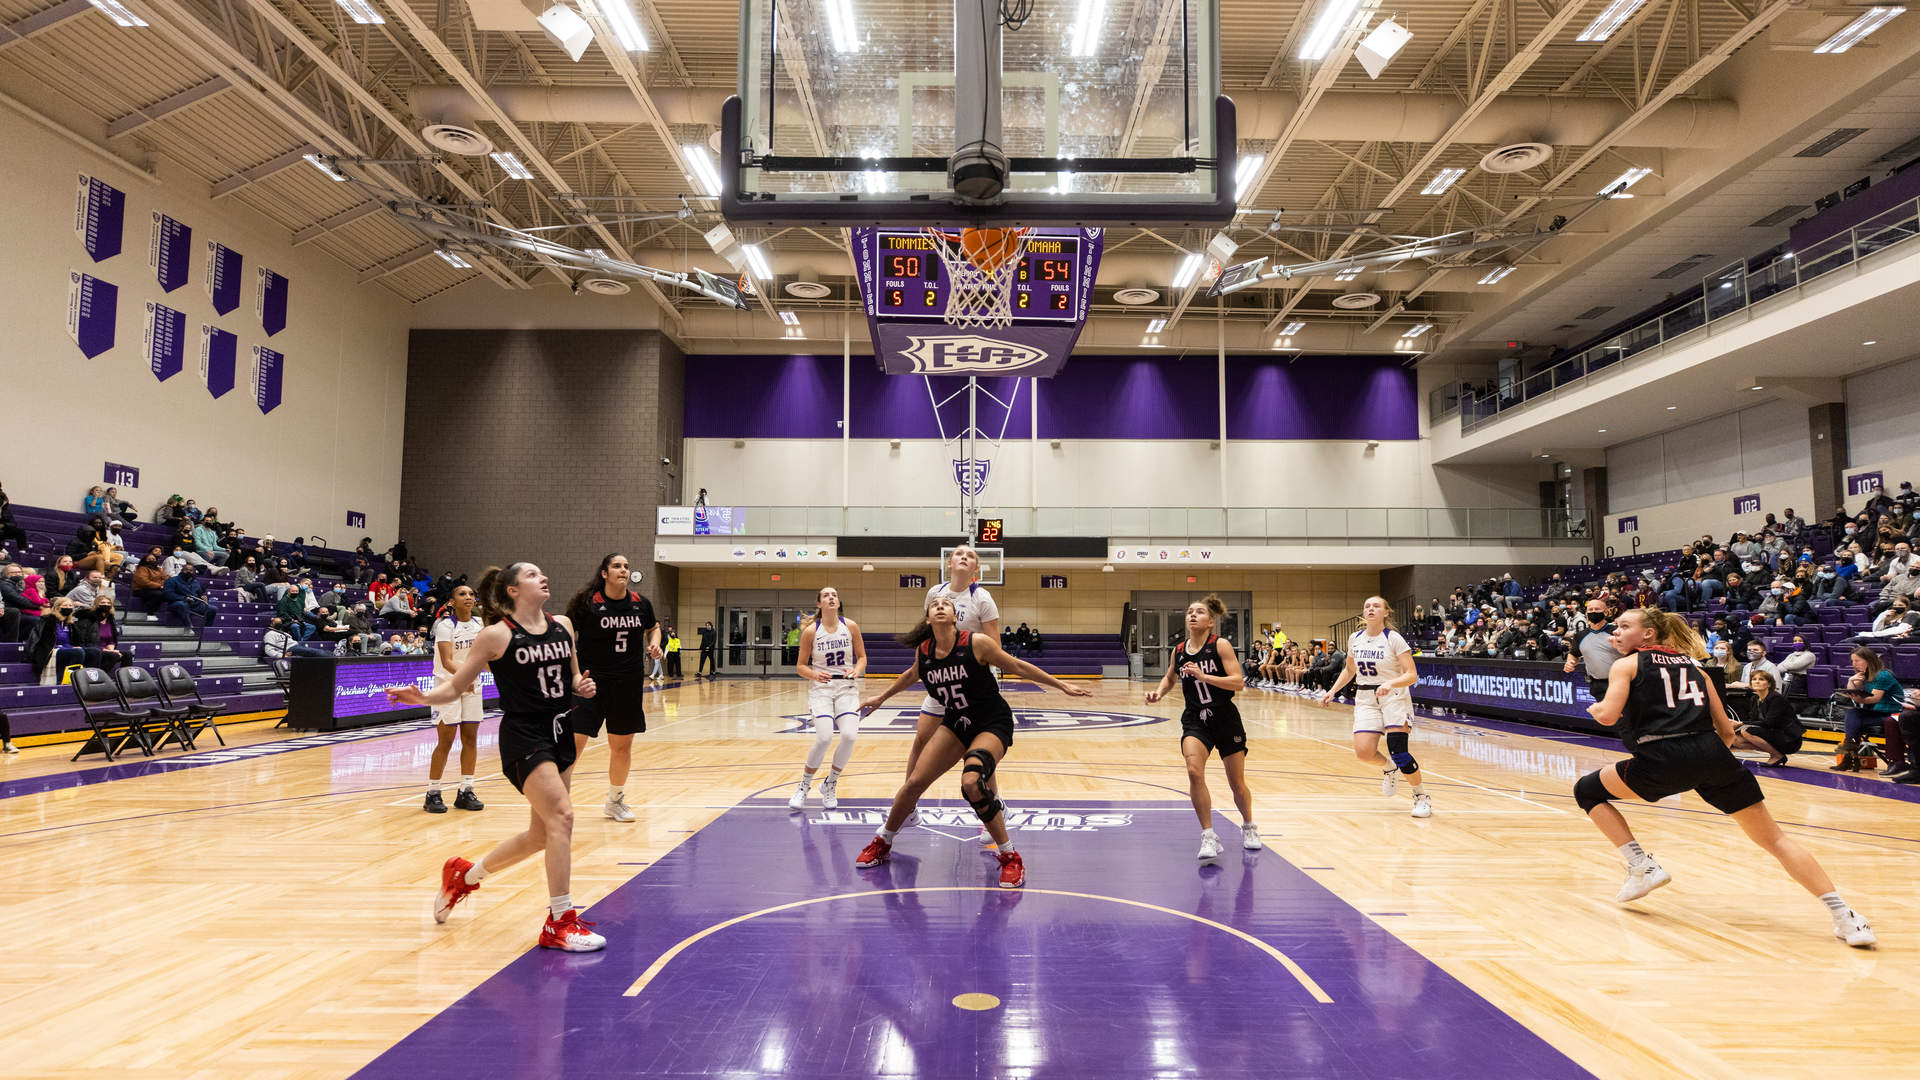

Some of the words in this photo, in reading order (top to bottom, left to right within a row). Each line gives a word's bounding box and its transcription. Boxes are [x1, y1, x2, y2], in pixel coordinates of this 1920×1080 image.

[888, 237, 935, 250] TOMMIES
[1028, 241, 1061, 253] OMAHA
[893, 257, 918, 277] 50
[1043, 261, 1068, 280] 54
[893, 291, 902, 305] 5
[926, 291, 935, 306] 2
[1019, 293, 1028, 308] 2
[1058, 295, 1067, 309] 2
[114, 469, 135, 487] 113
[1739, 499, 1758, 513] 102
[352, 516, 363, 528] 114
[1624, 520, 1635, 533] 101
[982, 528, 999, 542] 22
[907, 578, 922, 588] 115
[1049, 579, 1064, 589] 116
[600, 616, 642, 630] OMAHA
[615, 631, 629, 653] 5
[515, 640, 573, 665] OMAHA
[825, 650, 846, 667] 22
[927, 664, 968, 684] OMAHA
[1357, 661, 1378, 677] 25
[536, 664, 565, 699] 13
[1456, 673, 1573, 704] TOMMIESPORTS.COM
[1659, 667, 1705, 708] 14
[937, 684, 969, 710] 25
